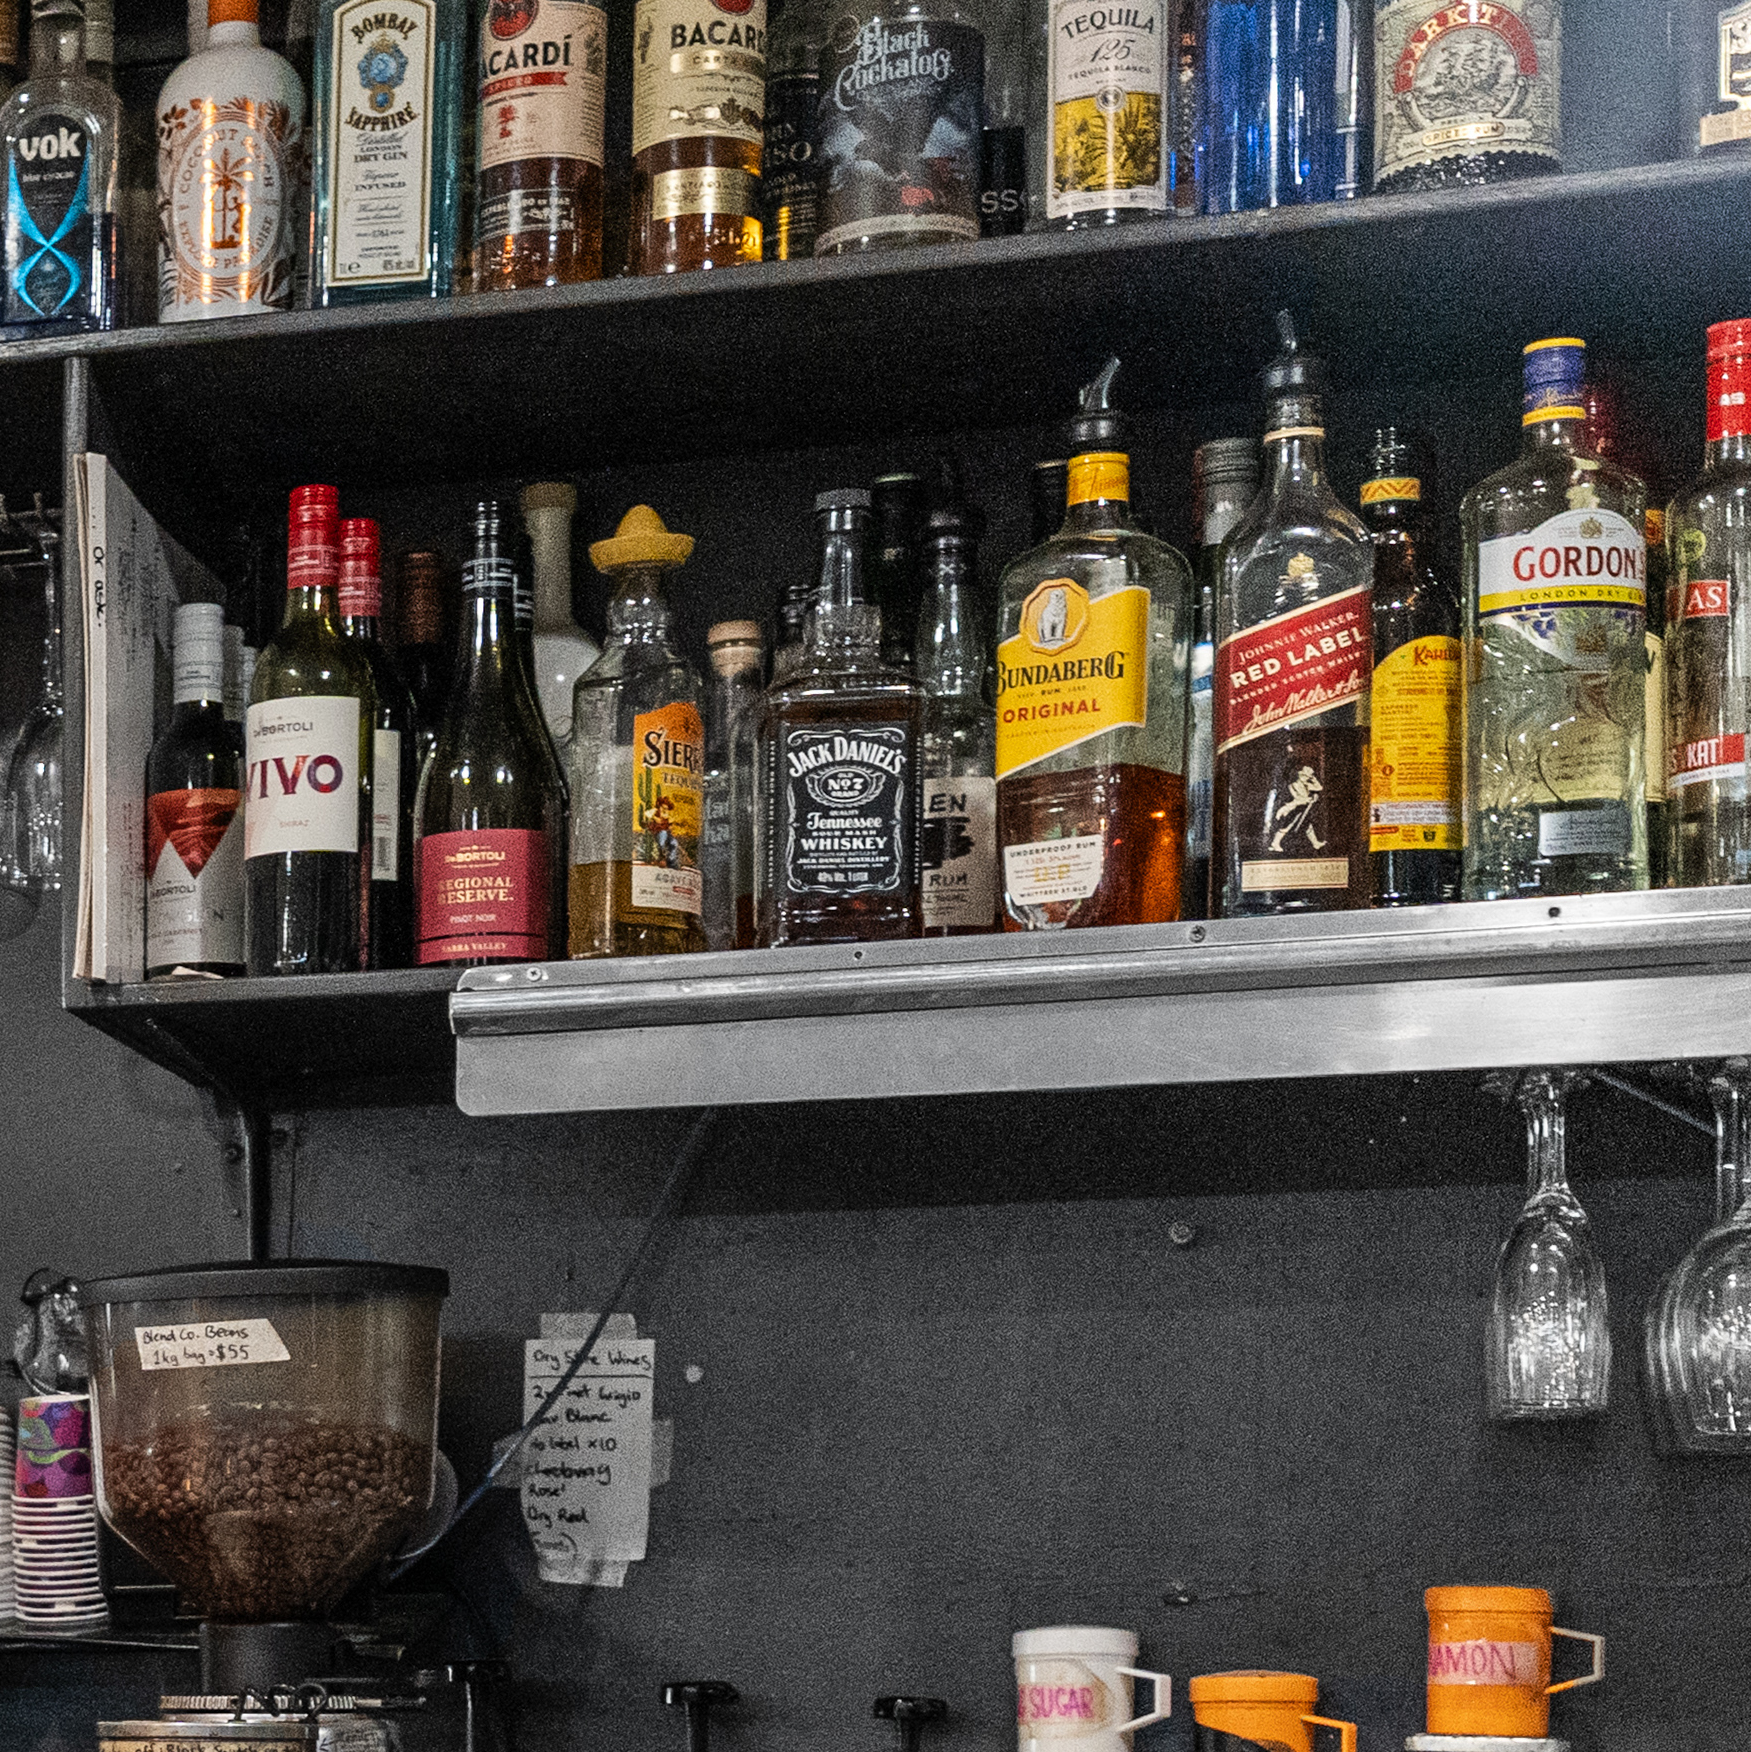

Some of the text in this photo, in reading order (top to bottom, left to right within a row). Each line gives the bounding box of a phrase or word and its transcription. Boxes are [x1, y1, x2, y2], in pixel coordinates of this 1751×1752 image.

[351, 13, 417, 44] BOMBAY
[1061, 8, 1155, 39] TEQUILA
[857, 18, 930, 66] Black
[1068, 66, 1110, 80] TEQUILA
[344, 102, 419, 132] SAPPHIRE
[19, 127, 82, 161] vok
[353, 152, 408, 163] DRY GIN
[354, 181, 406, 192] INFUSED
[1519, 588, 1621, 602] LONDON DRY
[1230, 627, 1365, 689] RED LABEL
[1238, 634, 1297, 665] JOHNNIE
[1282, 665, 1324, 685] SCOTCH
[1002, 699, 1101, 723] ORIGINAL
[787, 736, 907, 778] JACK DANIEL'S
[807, 812, 883, 829] Tennessee
[801, 837, 888, 851] WHISKEY
[1010, 841, 1096, 858] UNDERPROOF RUM
[143, 1330, 177, 1344] Blend
[205, 1325, 249, 1339] Beans
[154, 1346, 206, 1366] 1kg bag
[1031, 1687, 1094, 1720] SUGAR
